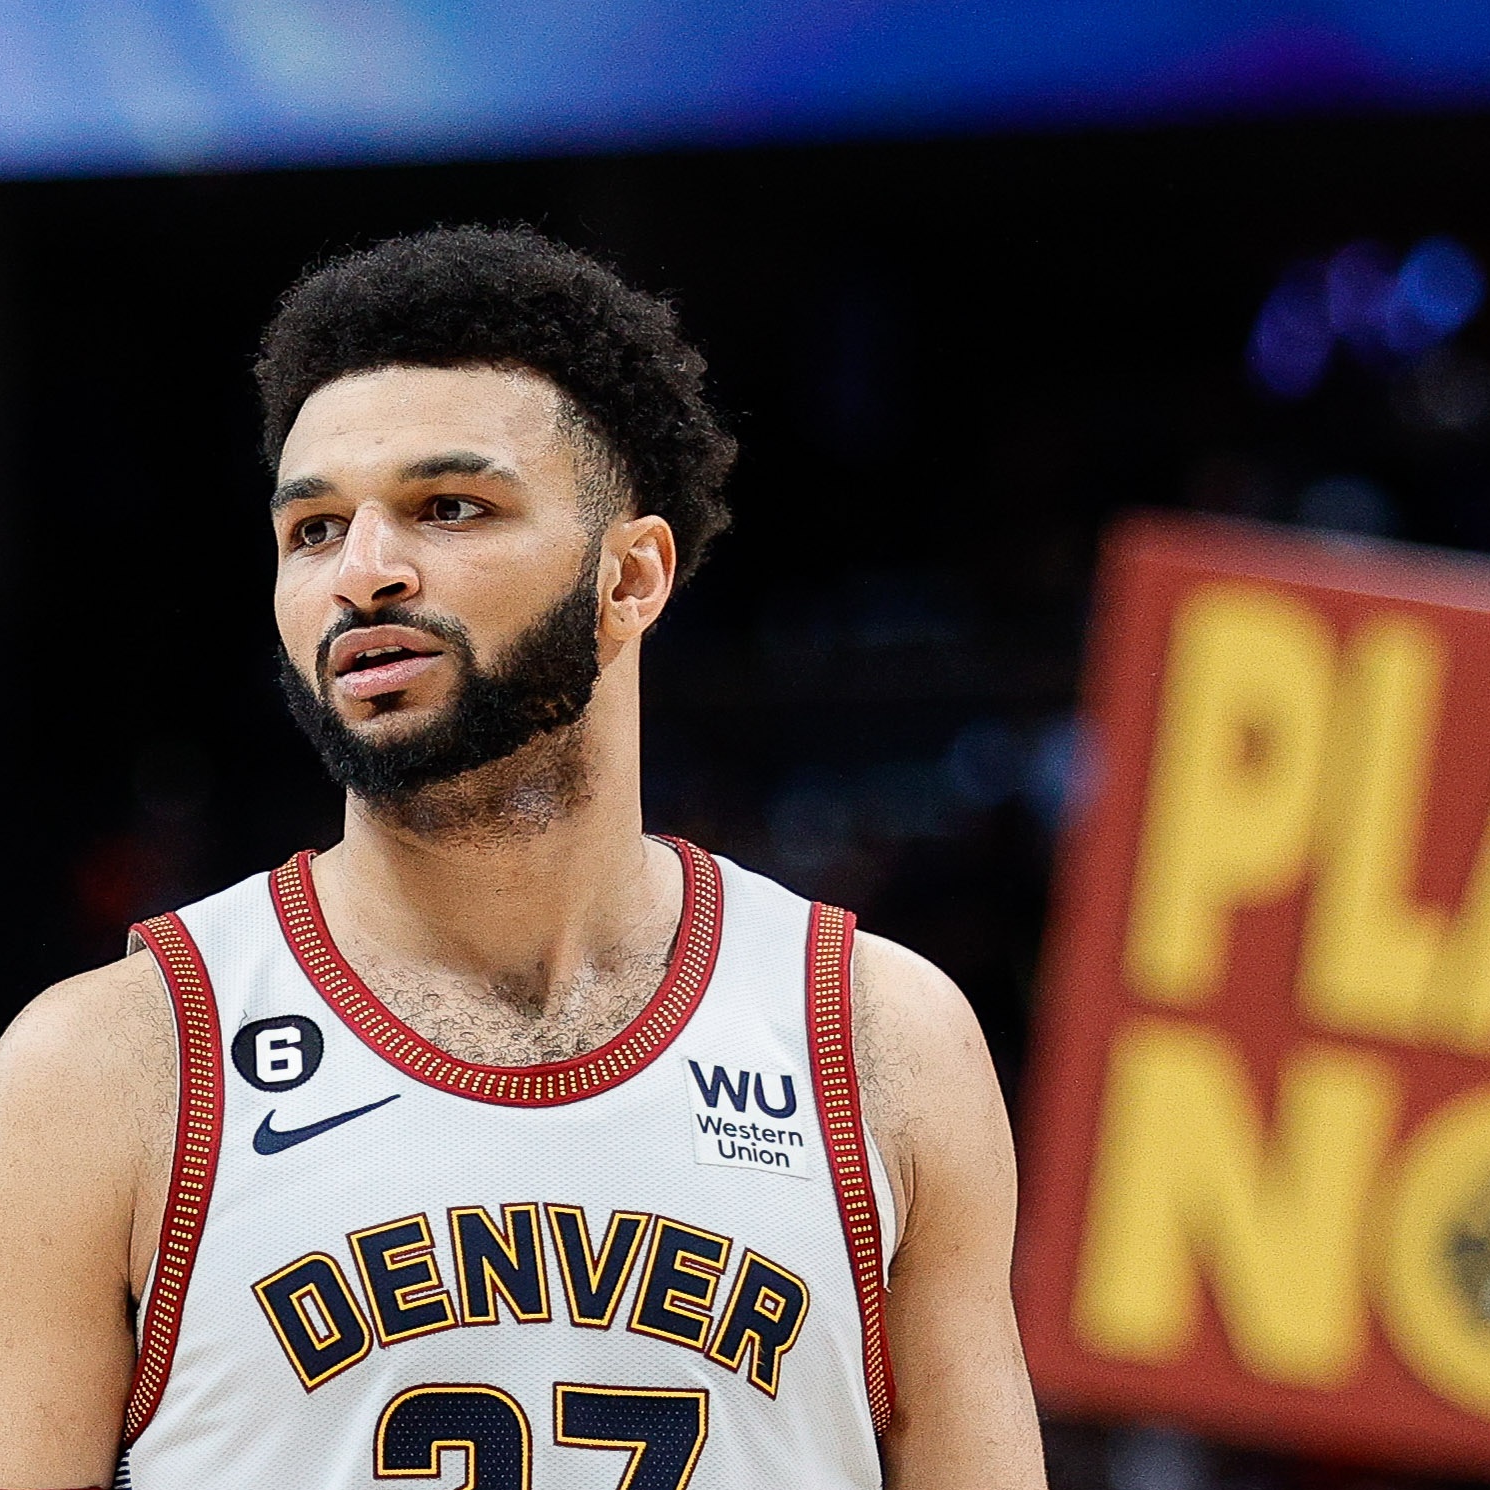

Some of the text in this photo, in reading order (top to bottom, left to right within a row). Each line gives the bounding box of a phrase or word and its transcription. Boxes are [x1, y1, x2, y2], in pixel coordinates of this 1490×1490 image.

[254, 1026, 303, 1083] 6
[688, 1059, 797, 1119] WU
[696, 1113, 804, 1147] Western
[717, 1139, 790, 1168] Union
[252, 1202, 811, 1400] DENVER
